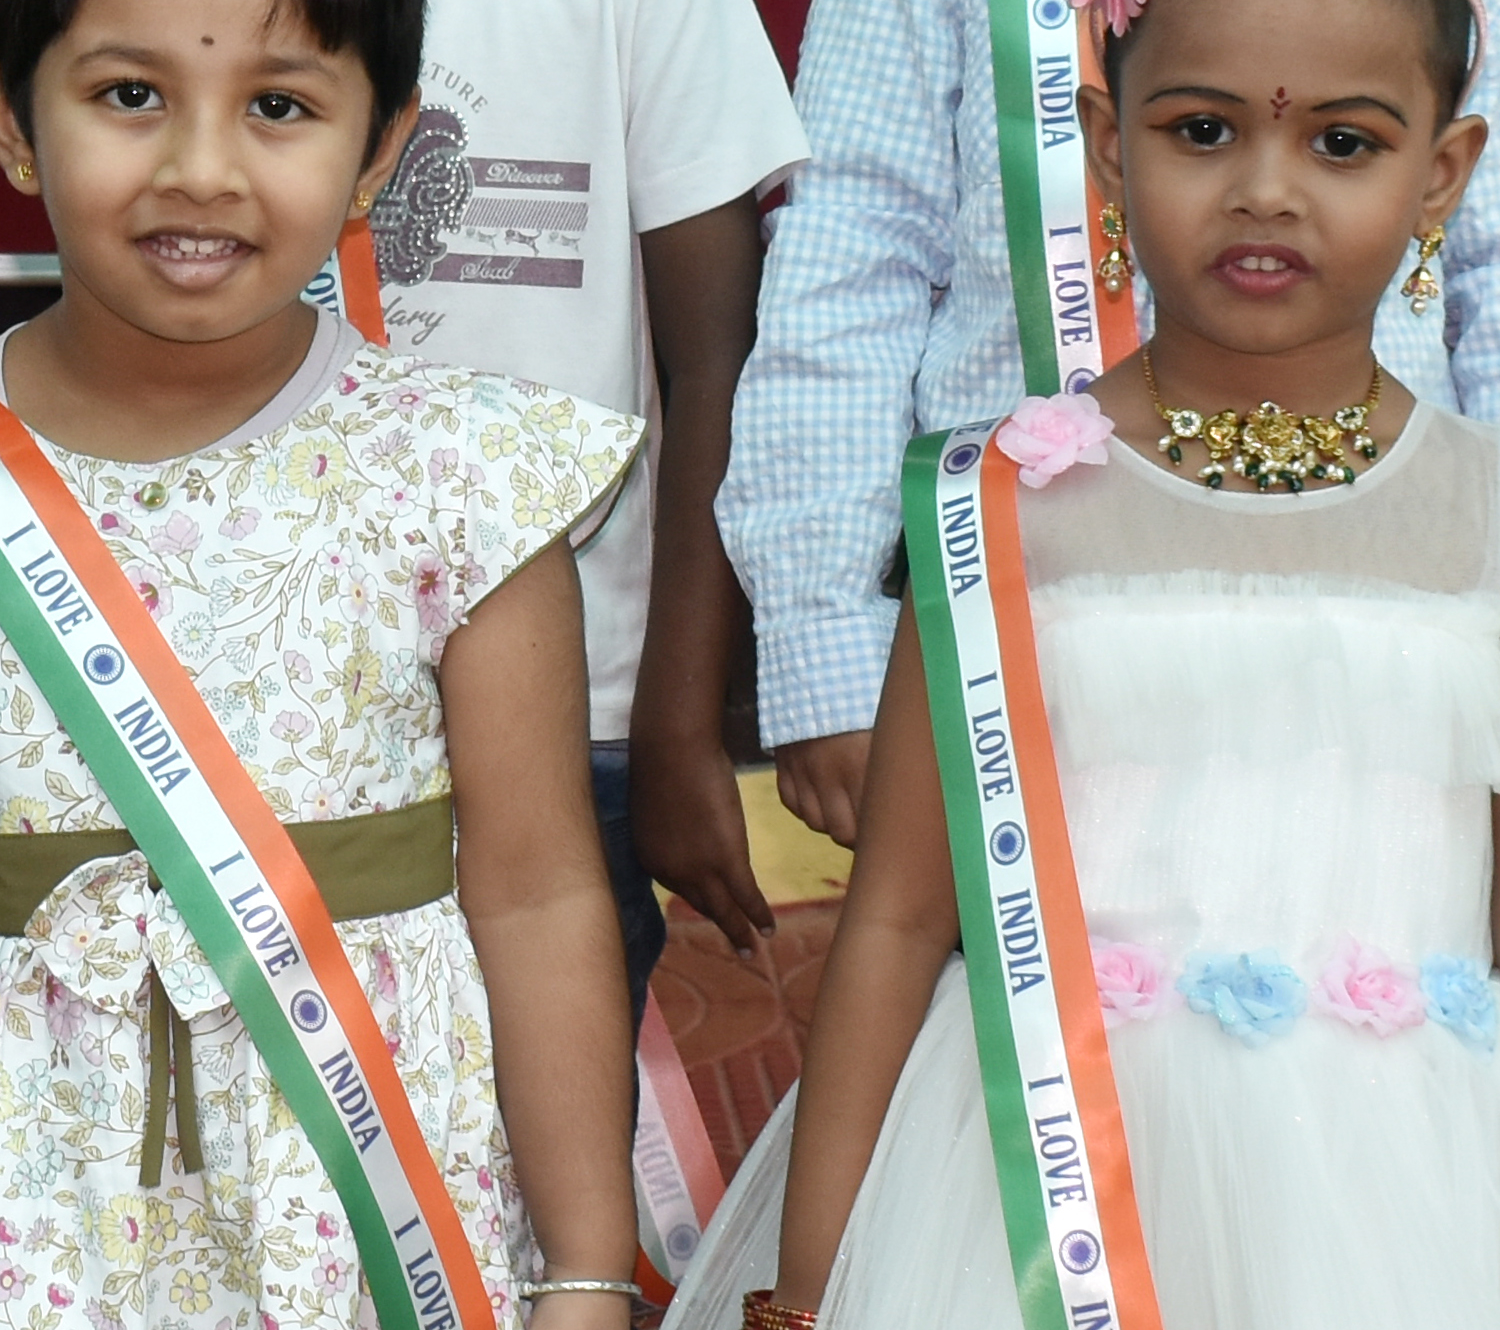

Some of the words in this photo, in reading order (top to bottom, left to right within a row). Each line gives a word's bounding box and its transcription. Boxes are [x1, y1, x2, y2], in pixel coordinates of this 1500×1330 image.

[1036, 53, 1077, 150] INDIA
[485, 162, 564, 185] Discover
[1048, 224, 1083, 237] I
[1051, 260, 1093, 349] LOVE
[3, 520, 38, 547] I
[942, 493, 983, 598] INDIA
[20, 549, 93, 637] LOVE
[967, 670, 998, 691] I
[114, 697, 192, 798] INDIA
[971, 706, 1016, 802] LOVE
[997, 888, 1047, 997] INDIA
[208, 850, 246, 877] I
[229, 882, 301, 978] LOVE
[318, 1047, 383, 1156] INDIA
[1027, 1073, 1065, 1092] I
[1033, 1109, 1088, 1209] LOVE
[394, 1215, 421, 1239] I
